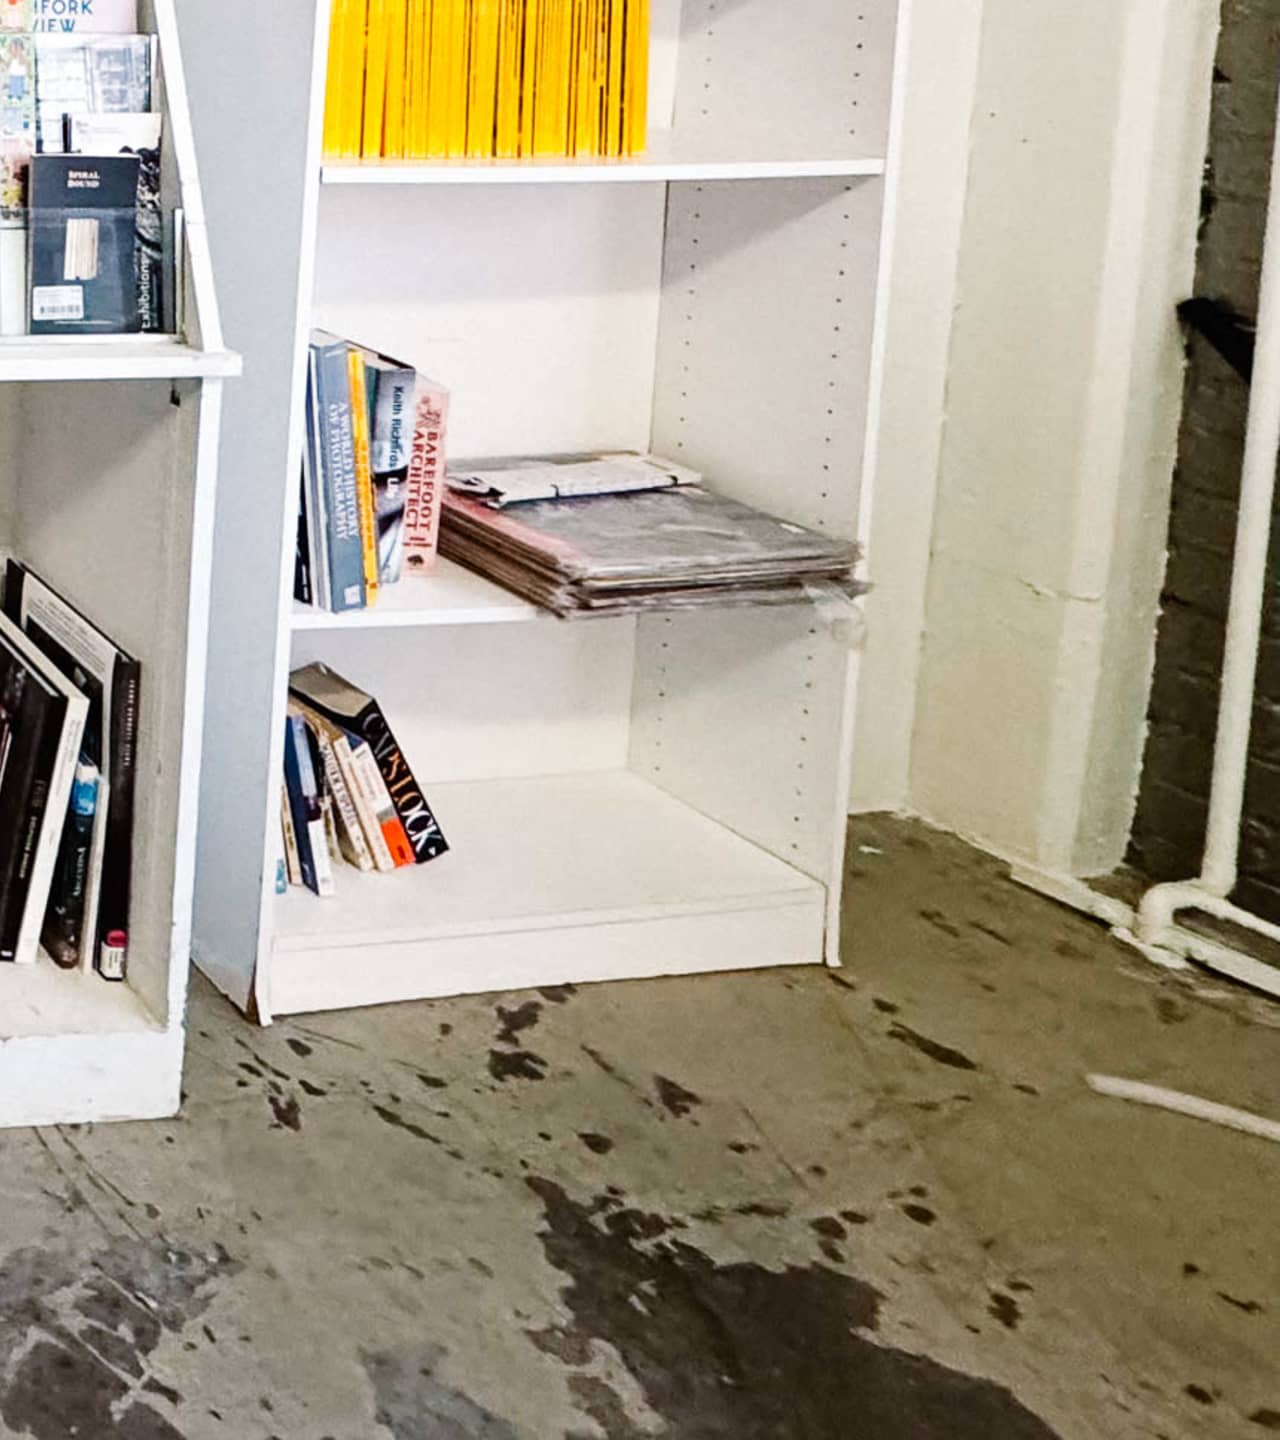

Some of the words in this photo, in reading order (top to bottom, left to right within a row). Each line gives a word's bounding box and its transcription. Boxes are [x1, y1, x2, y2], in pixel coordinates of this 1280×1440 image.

[392, 385, 405, 415] Keith
[339, 415, 354, 470] WORLD
[405, 430, 425, 530] ARCHITECT
[421, 431, 439, 532] BAREFOOT
[331, 428, 348, 541] PHOTOGRAPHY
[343, 474, 359, 538] HISTORY
[389, 774, 442, 852] LOCK
